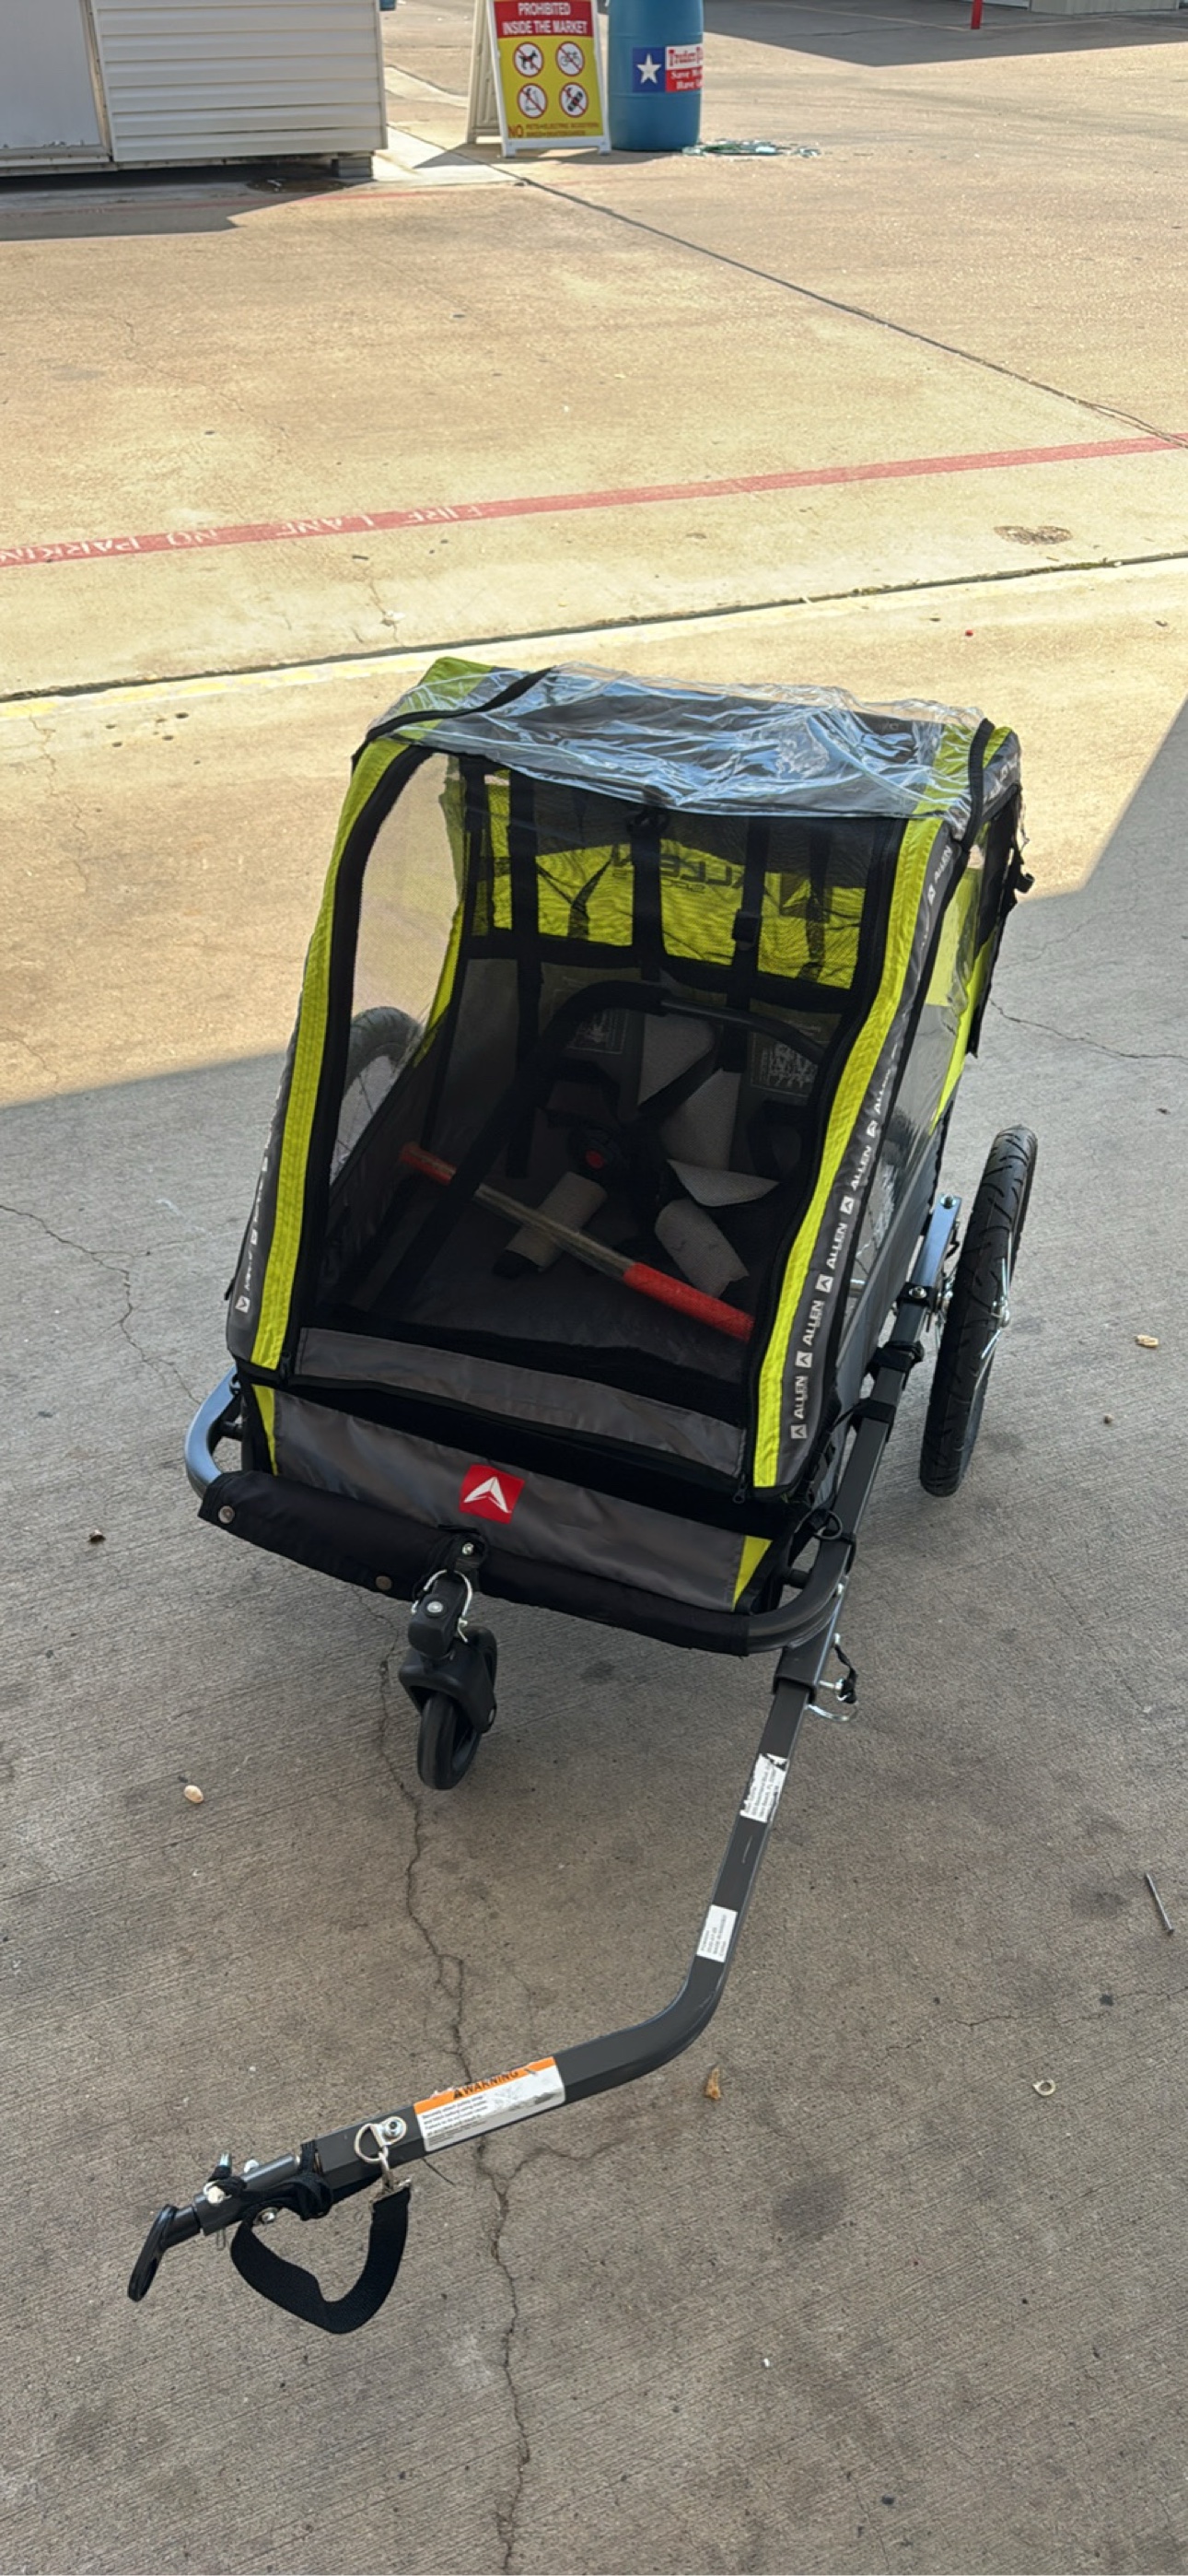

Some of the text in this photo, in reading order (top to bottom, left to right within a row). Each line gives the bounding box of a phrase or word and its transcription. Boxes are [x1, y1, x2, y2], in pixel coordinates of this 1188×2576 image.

[518, 2, 571, 16] PROHIBITED
[502, 20, 588, 35] INSIDE THE MARKET
[277, 514, 374, 536] LANE
[409, 506, 483, 522] FIRE
[168, 528, 217, 545] NO
[851, 1144, 872, 1191] ALLEN
[826, 1223, 847, 1270] ALLEN
[802, 1300, 825, 1346] ALLEN
[794, 1376, 809, 1419] ALLEN
[463, 2070, 519, 2094] WARNING
